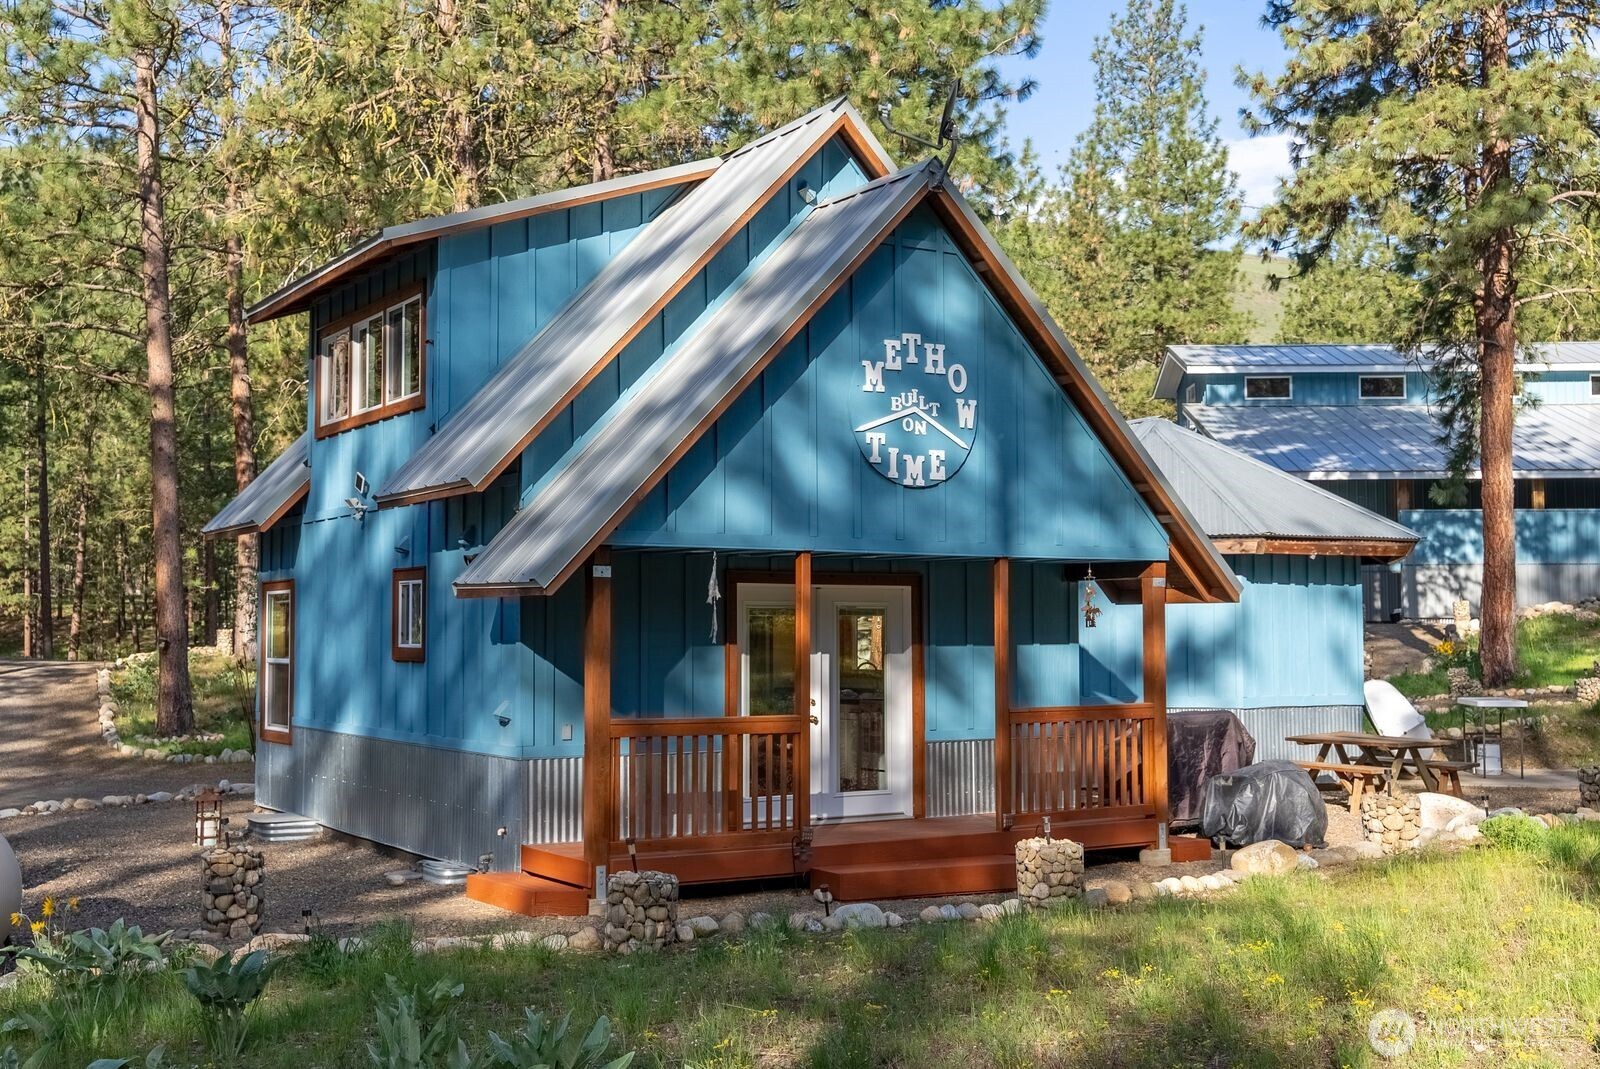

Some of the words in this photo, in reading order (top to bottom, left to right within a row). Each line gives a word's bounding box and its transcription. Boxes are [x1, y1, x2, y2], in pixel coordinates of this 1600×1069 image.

[861, 333, 977, 429] METHOW
[891, 388, 940, 417] BUILT
[902, 417, 927, 435] ON
[865, 432, 946, 486] TIME
